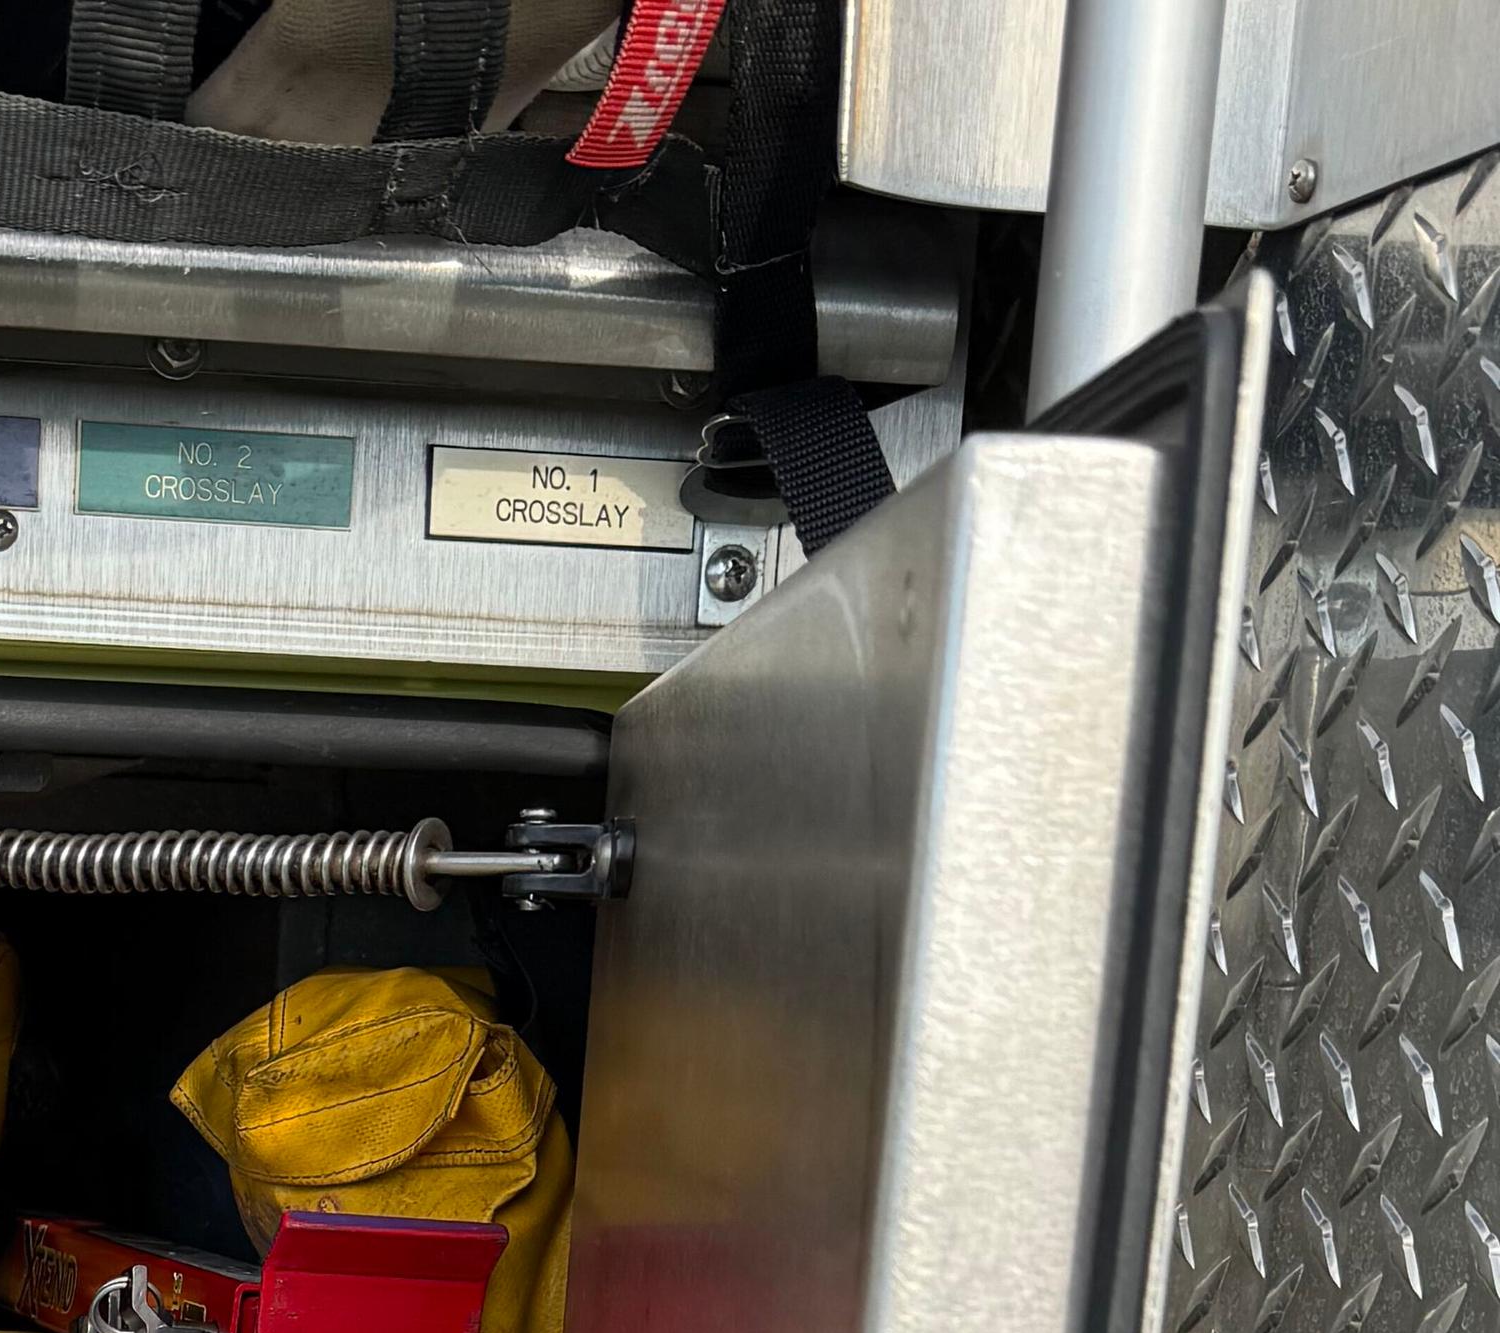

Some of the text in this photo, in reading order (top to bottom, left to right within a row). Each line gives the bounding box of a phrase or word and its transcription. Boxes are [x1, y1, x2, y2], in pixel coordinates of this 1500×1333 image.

[177, 441, 253, 470] NO. 2
[144, 474, 284, 505] CROSSLAY
[531, 464, 599, 493] NO. 1
[495, 498, 630, 529] CROSSLAY
